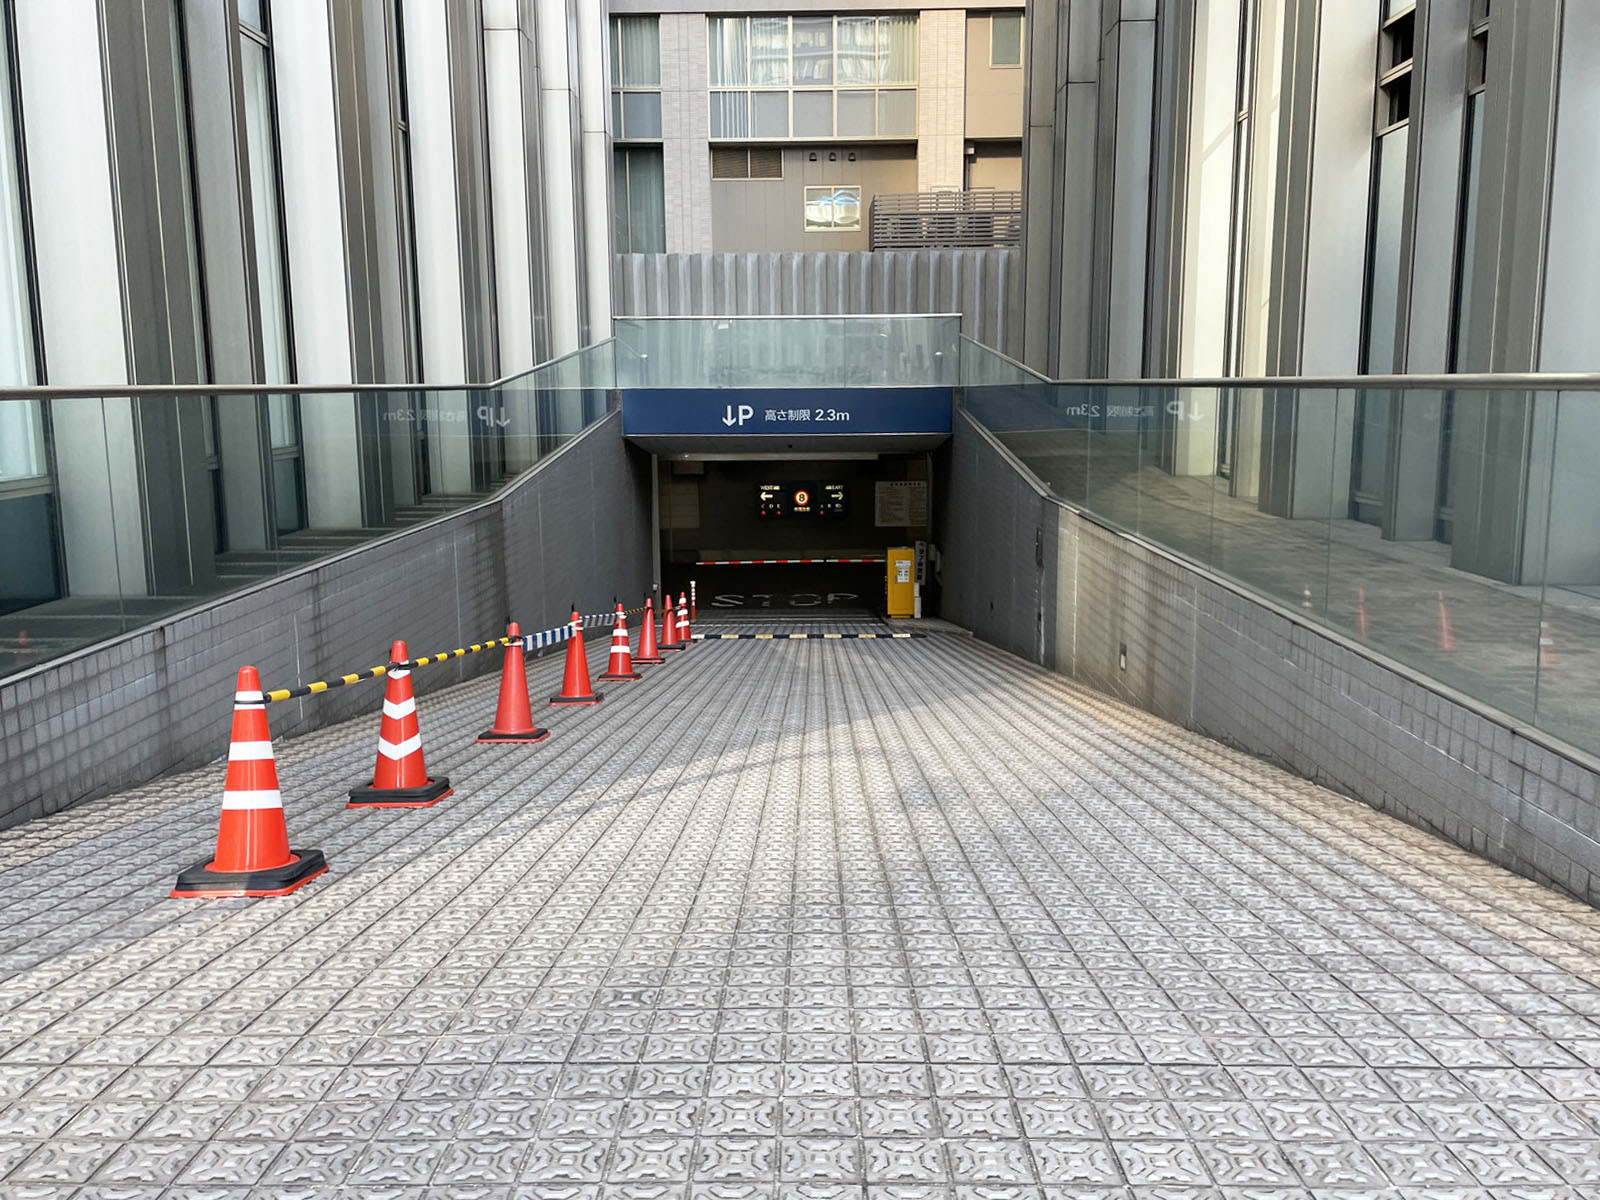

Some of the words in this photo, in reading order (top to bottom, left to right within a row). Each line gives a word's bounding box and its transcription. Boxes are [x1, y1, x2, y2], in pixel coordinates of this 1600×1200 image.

[738, 405, 753, 425] P
[765, 409, 811, 422] 高さ制限
[815, 409, 850, 421] 2.3m
[711, 593, 859, 607] STOP
